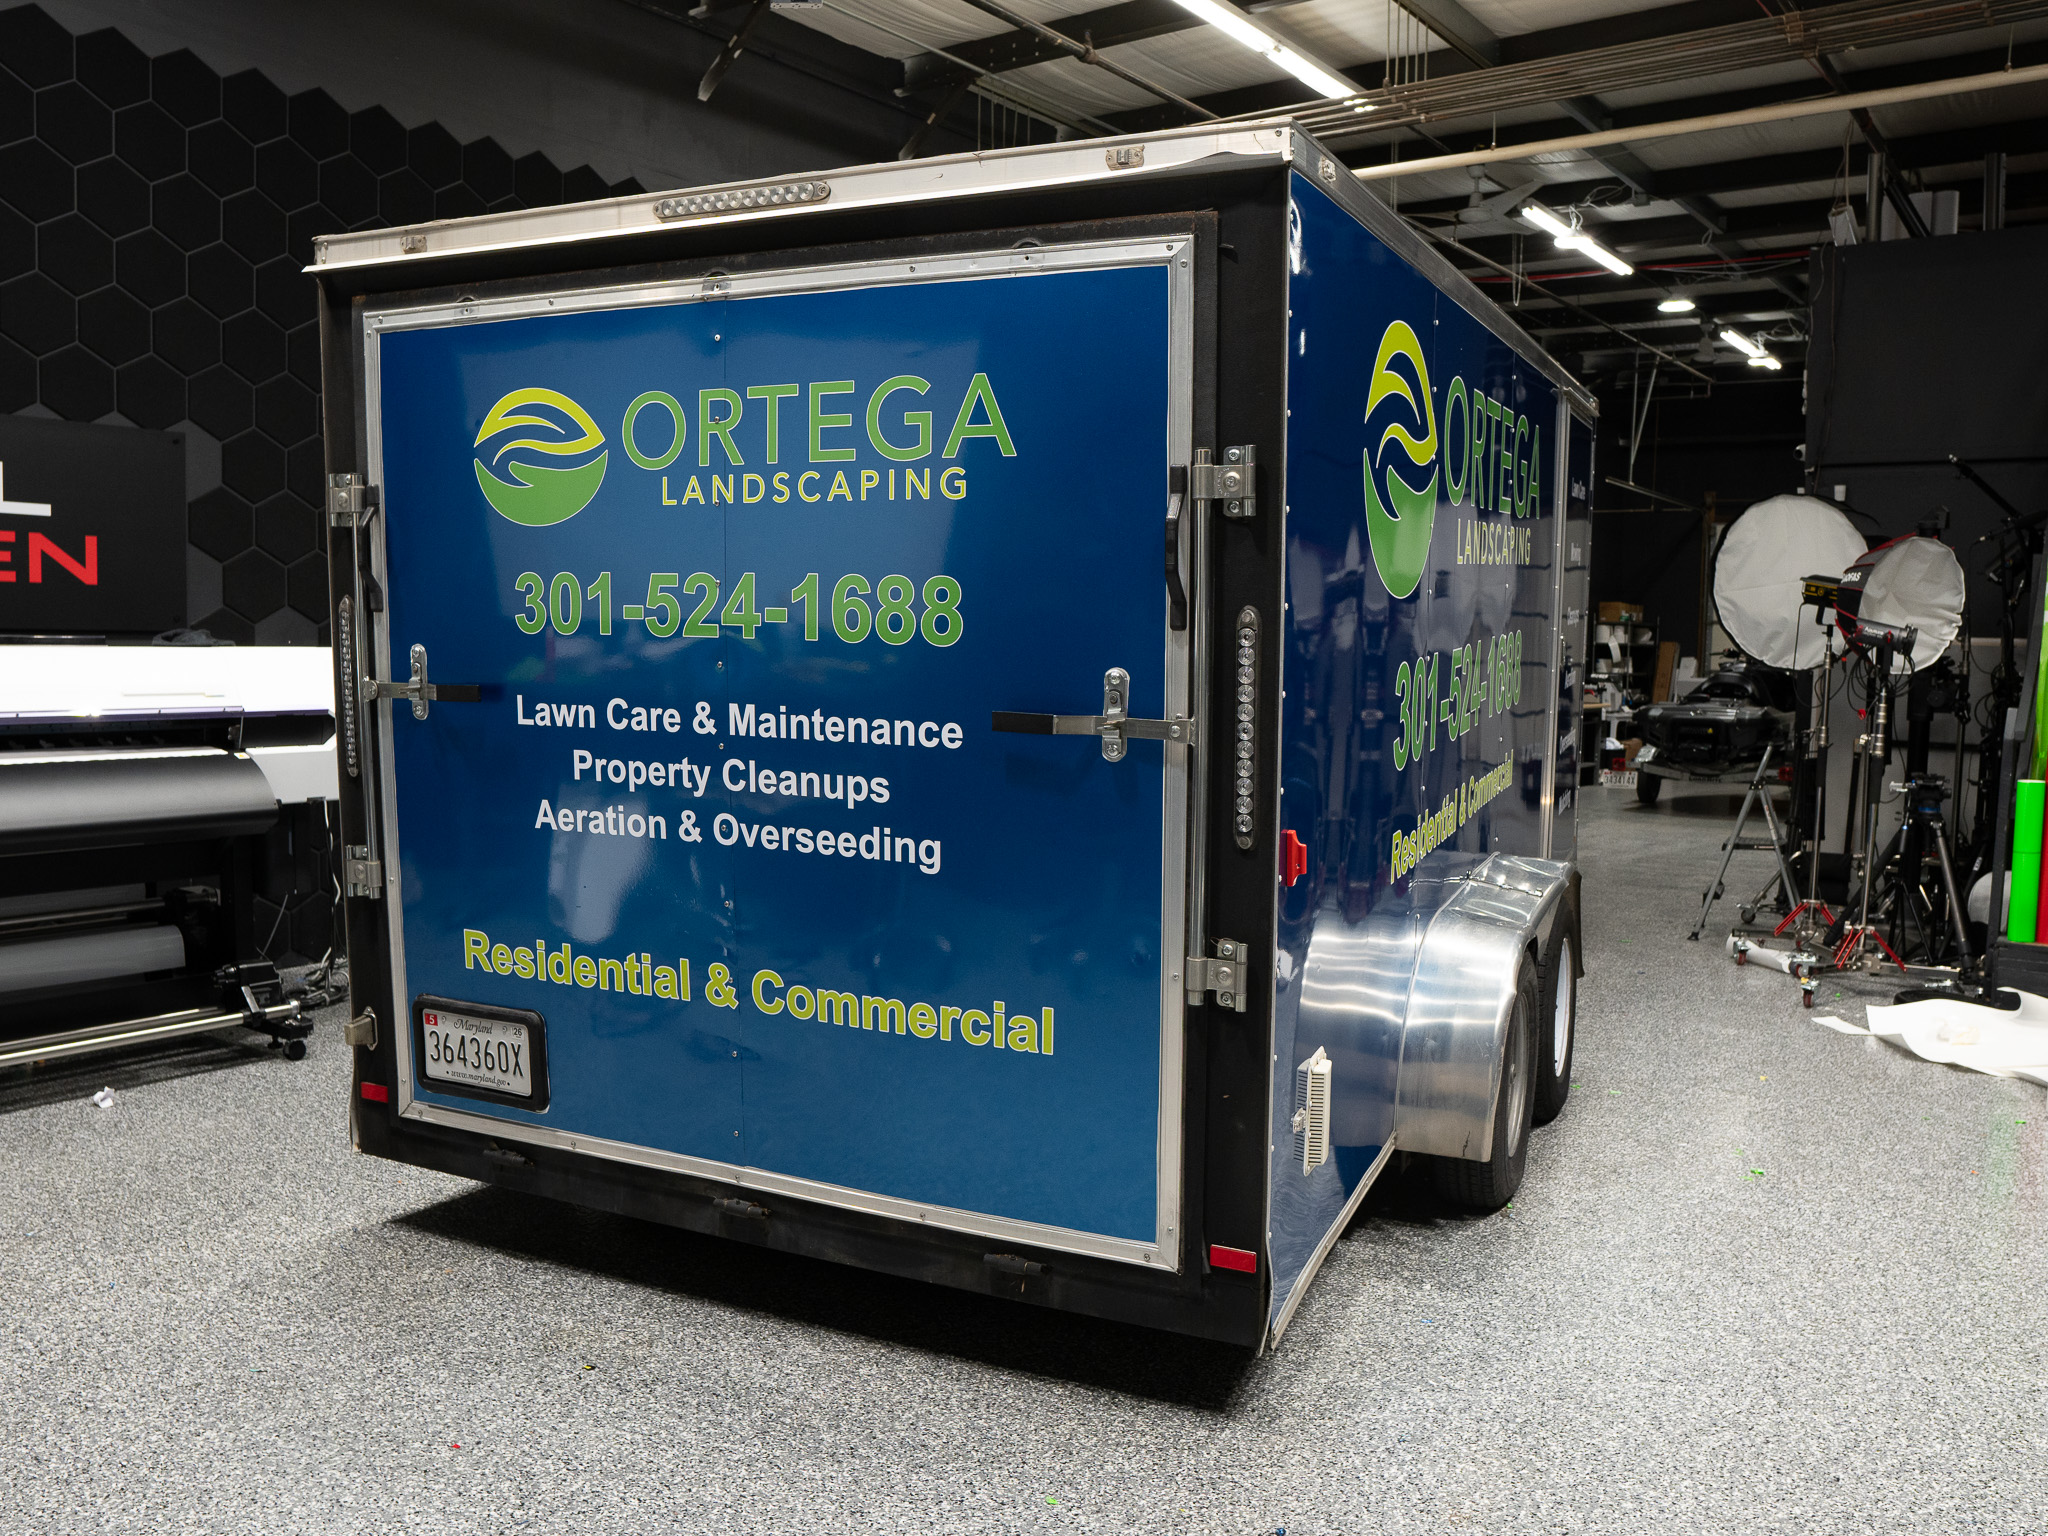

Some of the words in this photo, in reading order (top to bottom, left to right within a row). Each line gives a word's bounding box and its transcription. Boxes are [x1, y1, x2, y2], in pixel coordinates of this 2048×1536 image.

[622, 372, 1017, 471] ORTEGA
[1444, 375, 1540, 520] ORTEGA
[661, 466, 967, 506] LANDSCAPING
[1456, 518, 1531, 566] LANDSCAPING
[514, 571, 965, 648] 301-524-1688
[516, 694, 596, 729] Lawn
[606, 697, 681, 733] Care
[692, 701, 718, 735] &
[728, 702, 964, 749] Maintenance
[1393, 629, 1522, 772] 301-524-1688
[573, 749, 712, 798] Property
[722, 758, 890, 810] Cleanups
[535, 799, 668, 840] Aeration
[678, 809, 703, 843] &
[713, 812, 942, 875] Overseeding
[1390, 787, 1458, 885] Residential
[1459, 782, 1466, 827] &
[1468, 748, 1513, 818] Commercial
[429, 1014, 436, 1026] 5
[463, 928, 691, 1001] Residential
[705, 962, 739, 1010] &
[751, 969, 1054, 1056] Commercial
[429, 1029, 524, 1078] 364360X
[453, 1018, 494, 1036] Maryland
[513, 1027, 523, 1037] 26
[450, 1069, 507, 1088] www.maryland.gov
